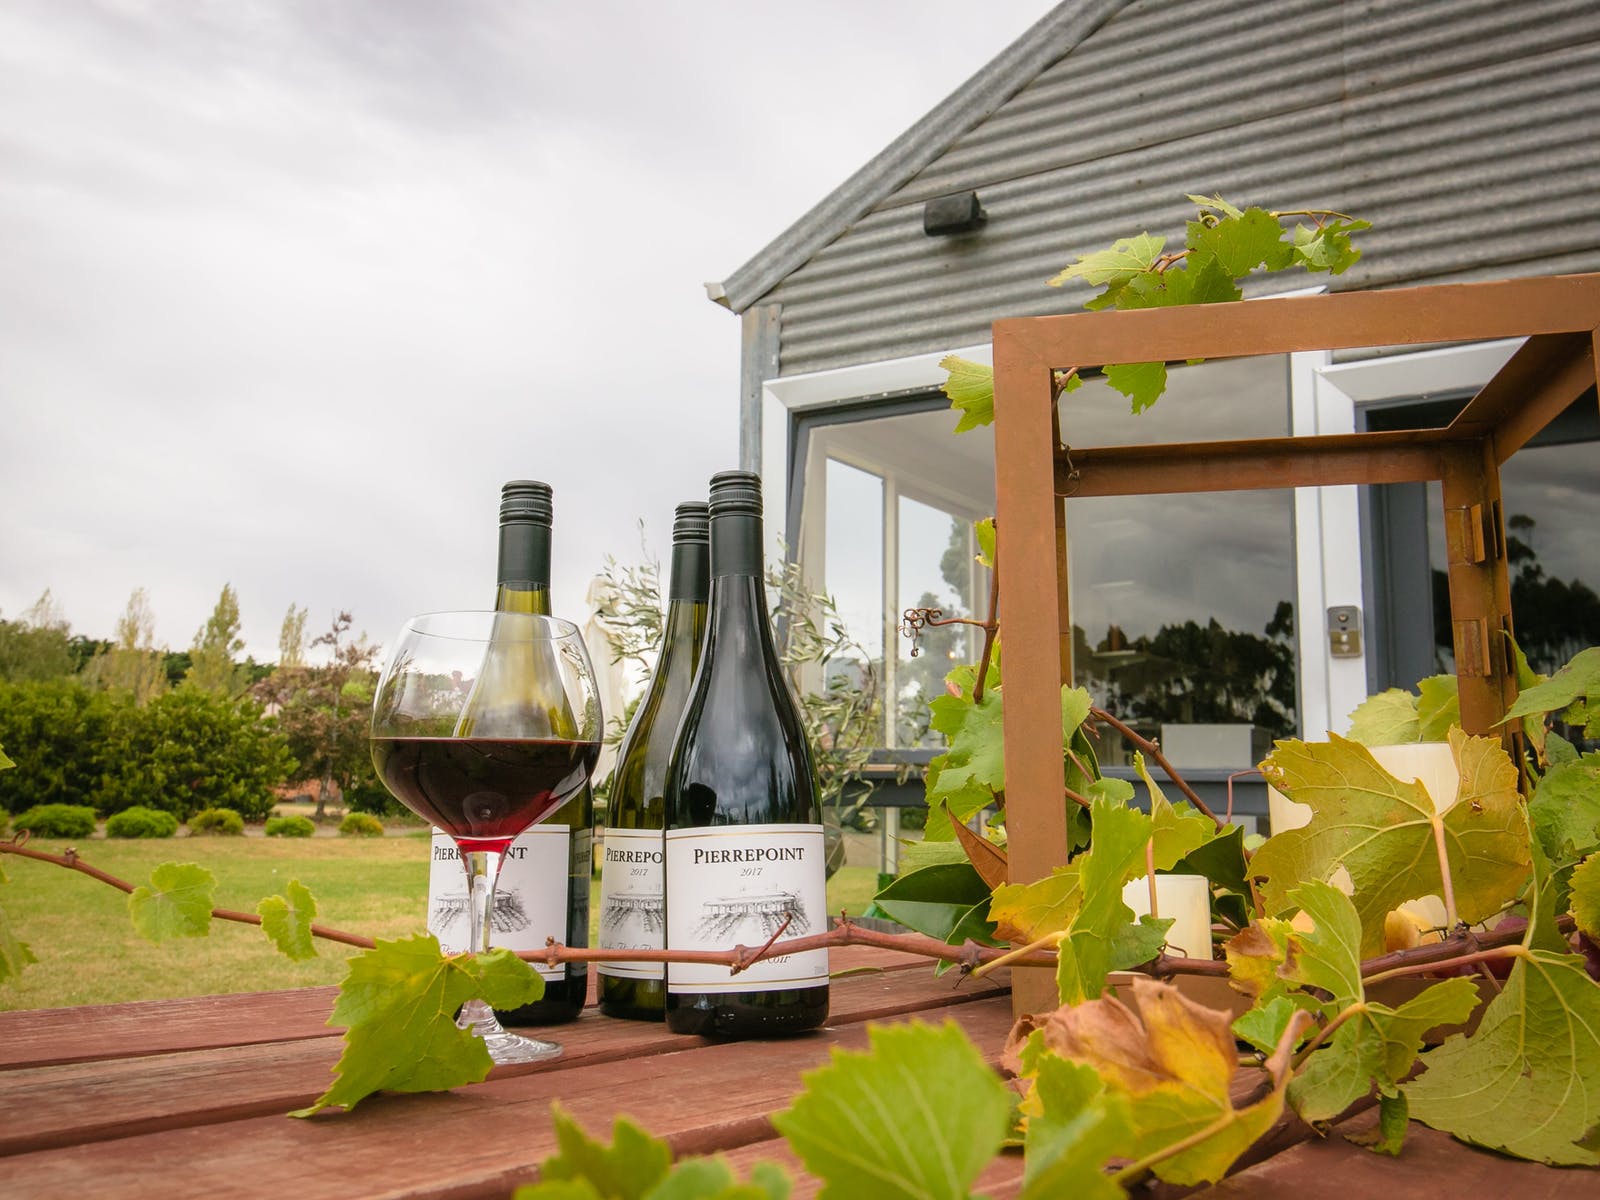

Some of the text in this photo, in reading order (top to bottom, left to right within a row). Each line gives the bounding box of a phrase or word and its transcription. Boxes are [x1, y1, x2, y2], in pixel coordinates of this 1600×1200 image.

[606, 847, 663, 864] PIERREPO
[694, 847, 805, 864] PIERREPOINT
[630, 868, 649, 876] 2017
[740, 867, 763, 877] 2017
